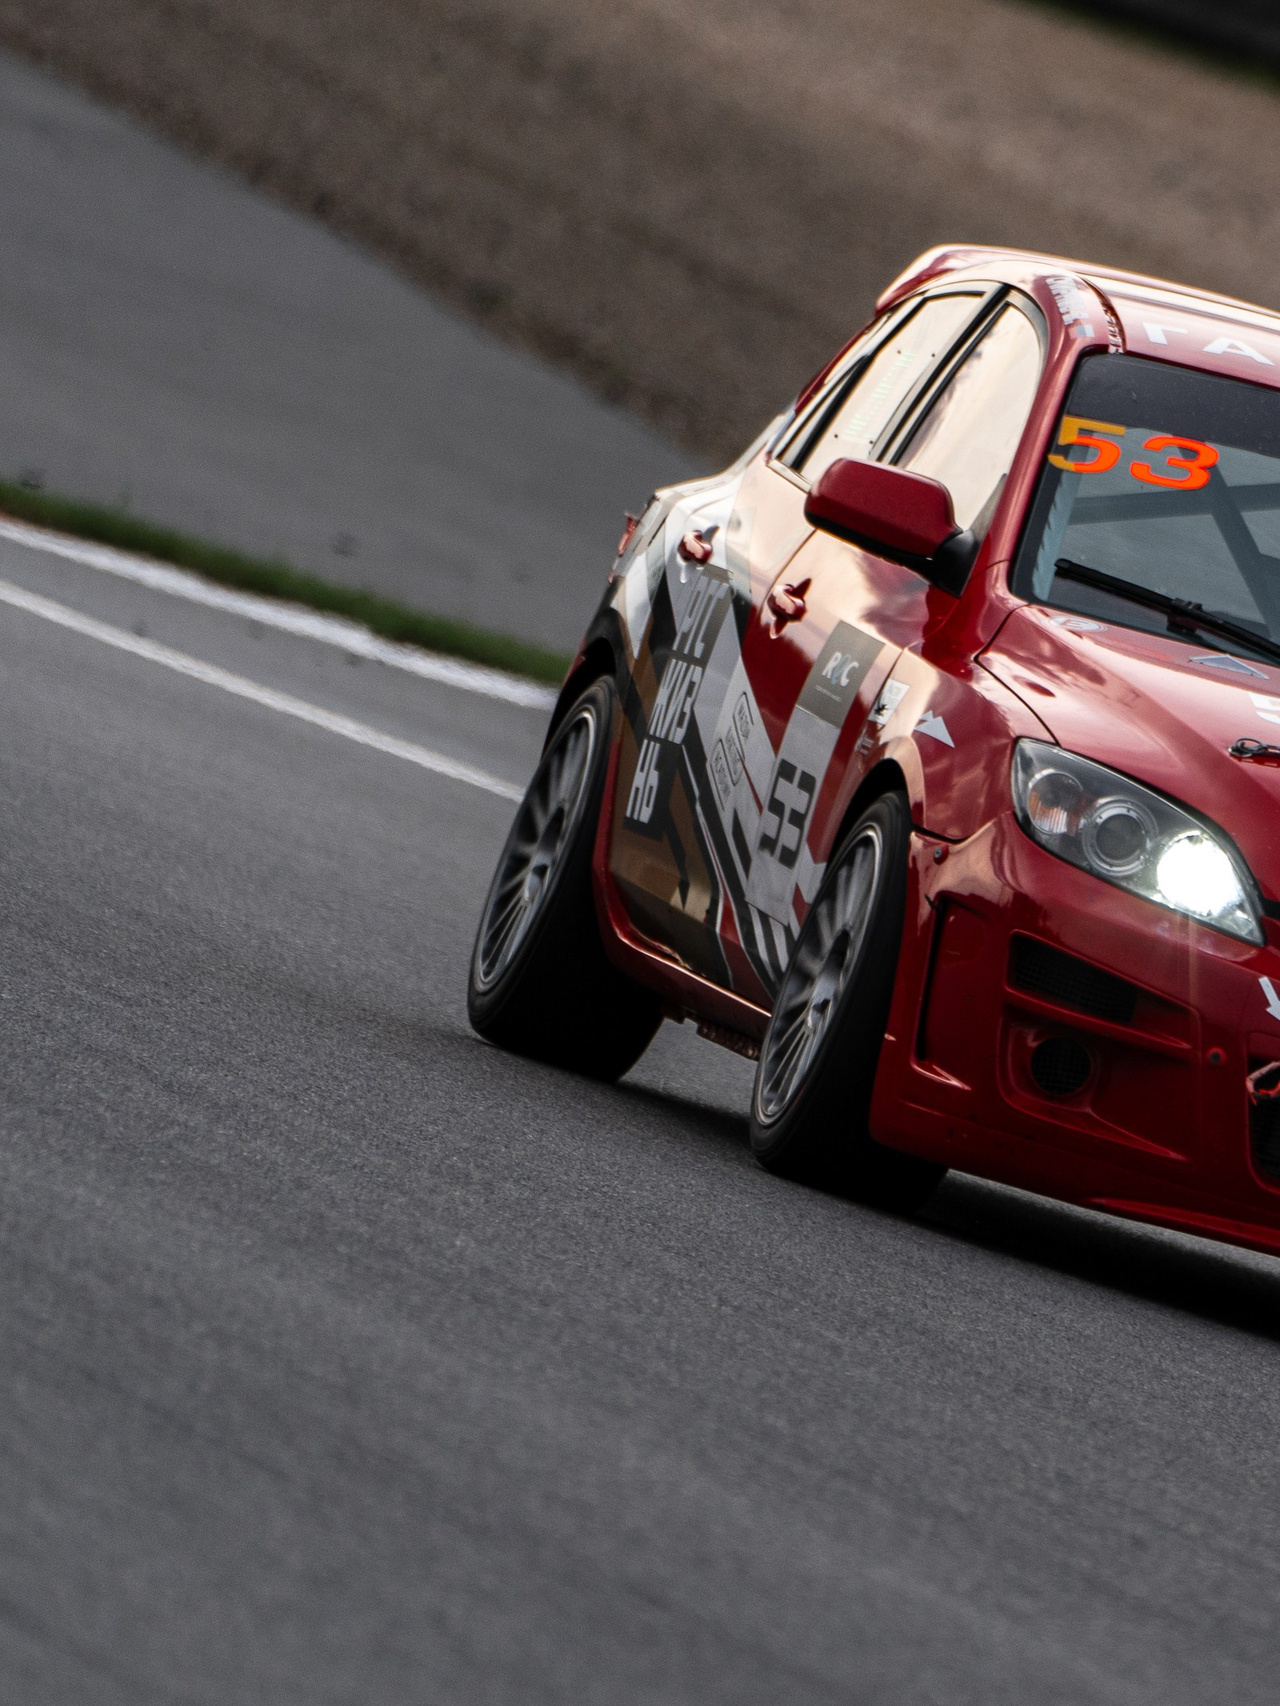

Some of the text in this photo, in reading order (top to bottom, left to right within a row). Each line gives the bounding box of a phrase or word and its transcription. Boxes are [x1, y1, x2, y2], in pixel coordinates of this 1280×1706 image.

[1047, 415, 1219, 490] 53
[648, 658, 702, 745] ЖИЗ
[758, 758, 817, 870] 53
